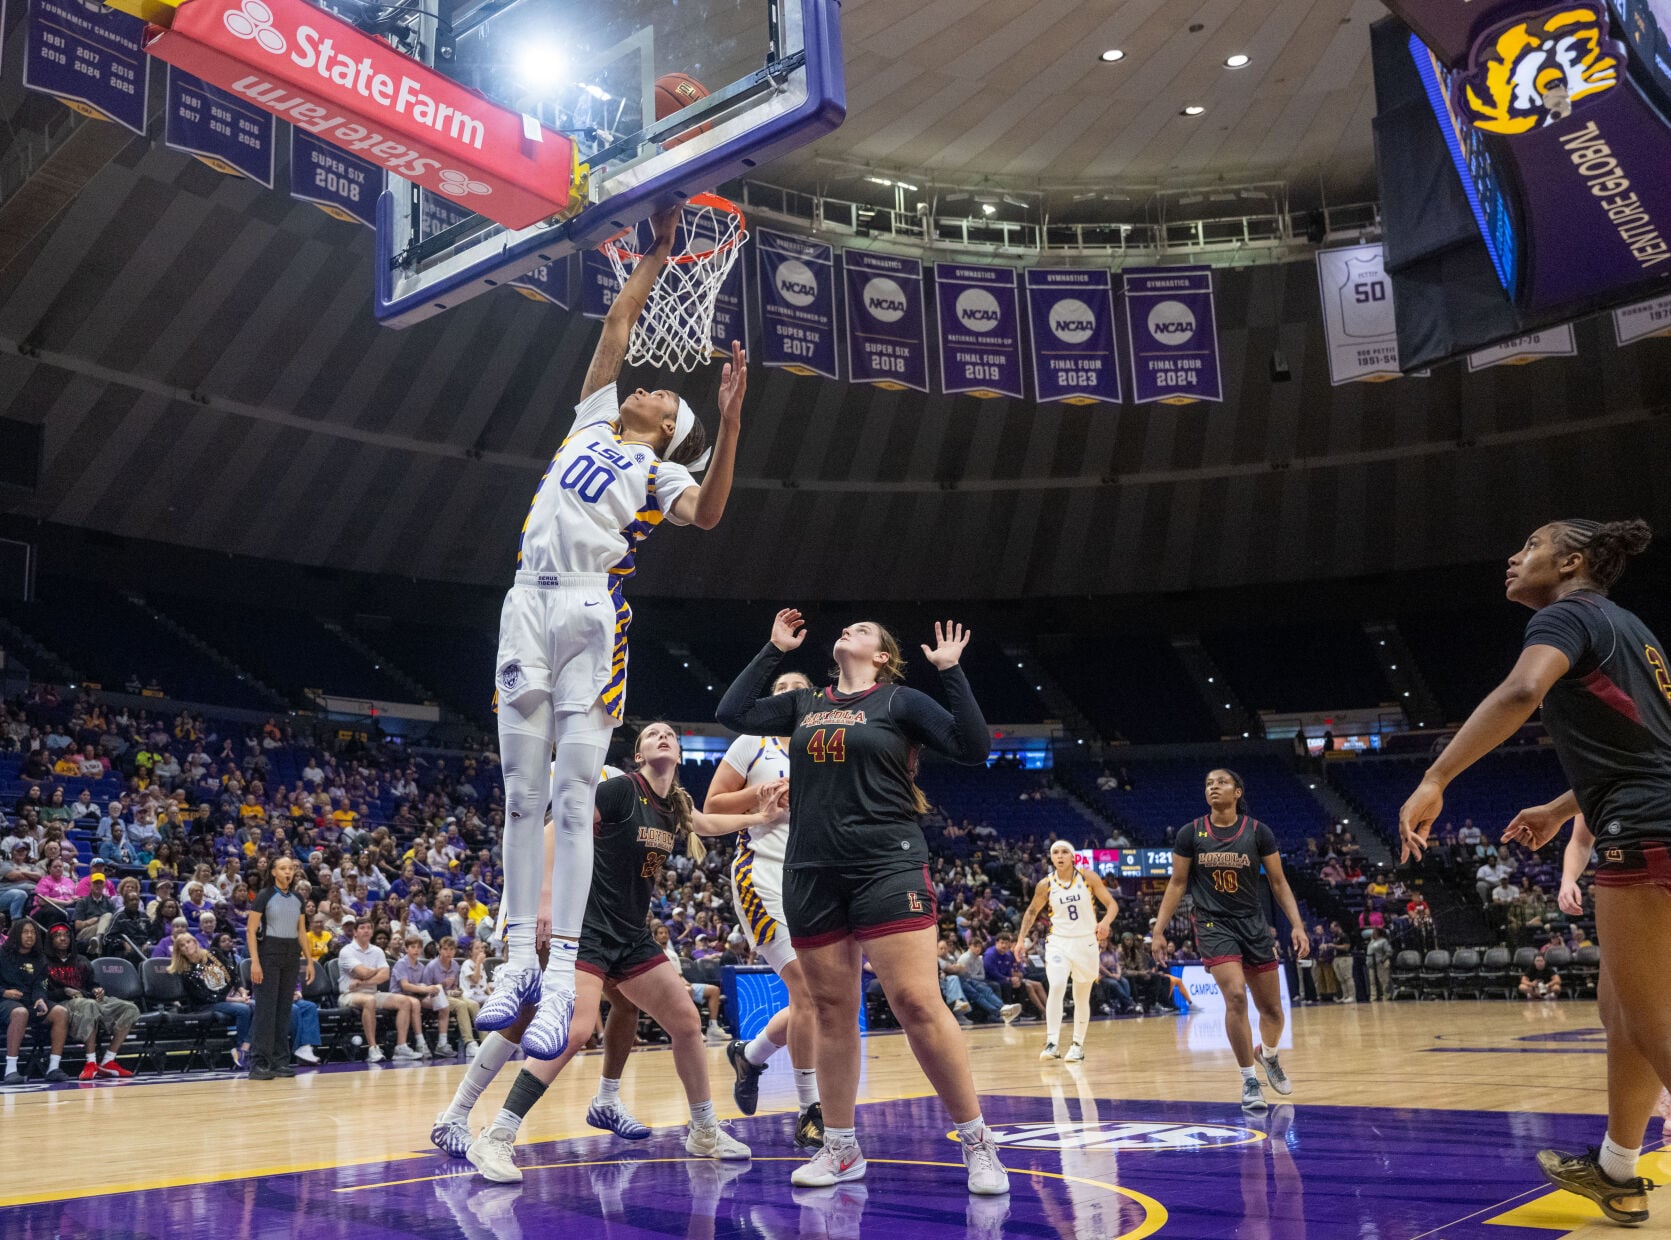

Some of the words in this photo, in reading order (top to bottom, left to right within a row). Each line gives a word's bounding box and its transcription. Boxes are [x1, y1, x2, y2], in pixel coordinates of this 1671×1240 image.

[41, 2, 92, 30] TOURNAMENT
[94, 25, 138, 51] CHAMPIONS
[43, 32, 65, 48] 1981
[76, 47, 99, 63] 2017
[41, 47, 66, 64] 2019
[74, 61, 100, 79] 2024
[179, 107, 200, 122] 2017
[1559, 120, 1630, 197] GLOBAL
[311, 151, 345, 175] SUPER
[348, 168, 365, 184] SIX
[315, 168, 360, 202] 2008
[1600, 192, 1671, 268] VENTURE
[956, 269, 996, 279] GYMNASTICS
[1047, 274, 1089, 282] GYMNASTICS
[780, 280, 816, 297] NCAA
[1146, 279, 1190, 288] GYMNASTICS
[1354, 281, 1386, 304] 50
[869, 298, 905, 312] NCAA
[961, 308, 998, 321] NCAA
[776, 325, 804, 338] SUPER
[806, 329, 820, 342] SIX
[1055, 320, 1093, 332] NCAA
[1154, 322, 1193, 334] NCAA
[783, 339, 814, 358] 2017
[865, 343, 893, 355] SUPER
[895, 346, 910, 357] SIX
[872, 355, 905, 372] 2018
[956, 353, 981, 364] FINAL
[983, 355, 1006, 365] FOUR
[1050, 359, 1076, 369] FINAL
[1078, 359, 1102, 369] FOUR
[1149, 360, 1175, 370] FINAL
[1178, 359, 1202, 369] FOUR
[965, 365, 999, 380] 2019
[1058, 371, 1097, 386] 2023
[1156, 371, 1197, 386] 2024
[586, 441, 633, 471] LSU
[560, 455, 616, 504] 00
[800, 709, 867, 727] LOYOLA
[807, 727, 846, 763] 44
[637, 826, 675, 847] LOYOL
[1198, 852, 1250, 867] LOYOLA
[1212, 869, 1239, 893] 10
[1059, 894, 1081, 905] LSU
[1067, 905, 1079, 921] 8
[1190, 984, 1219, 996] CAMPUS
